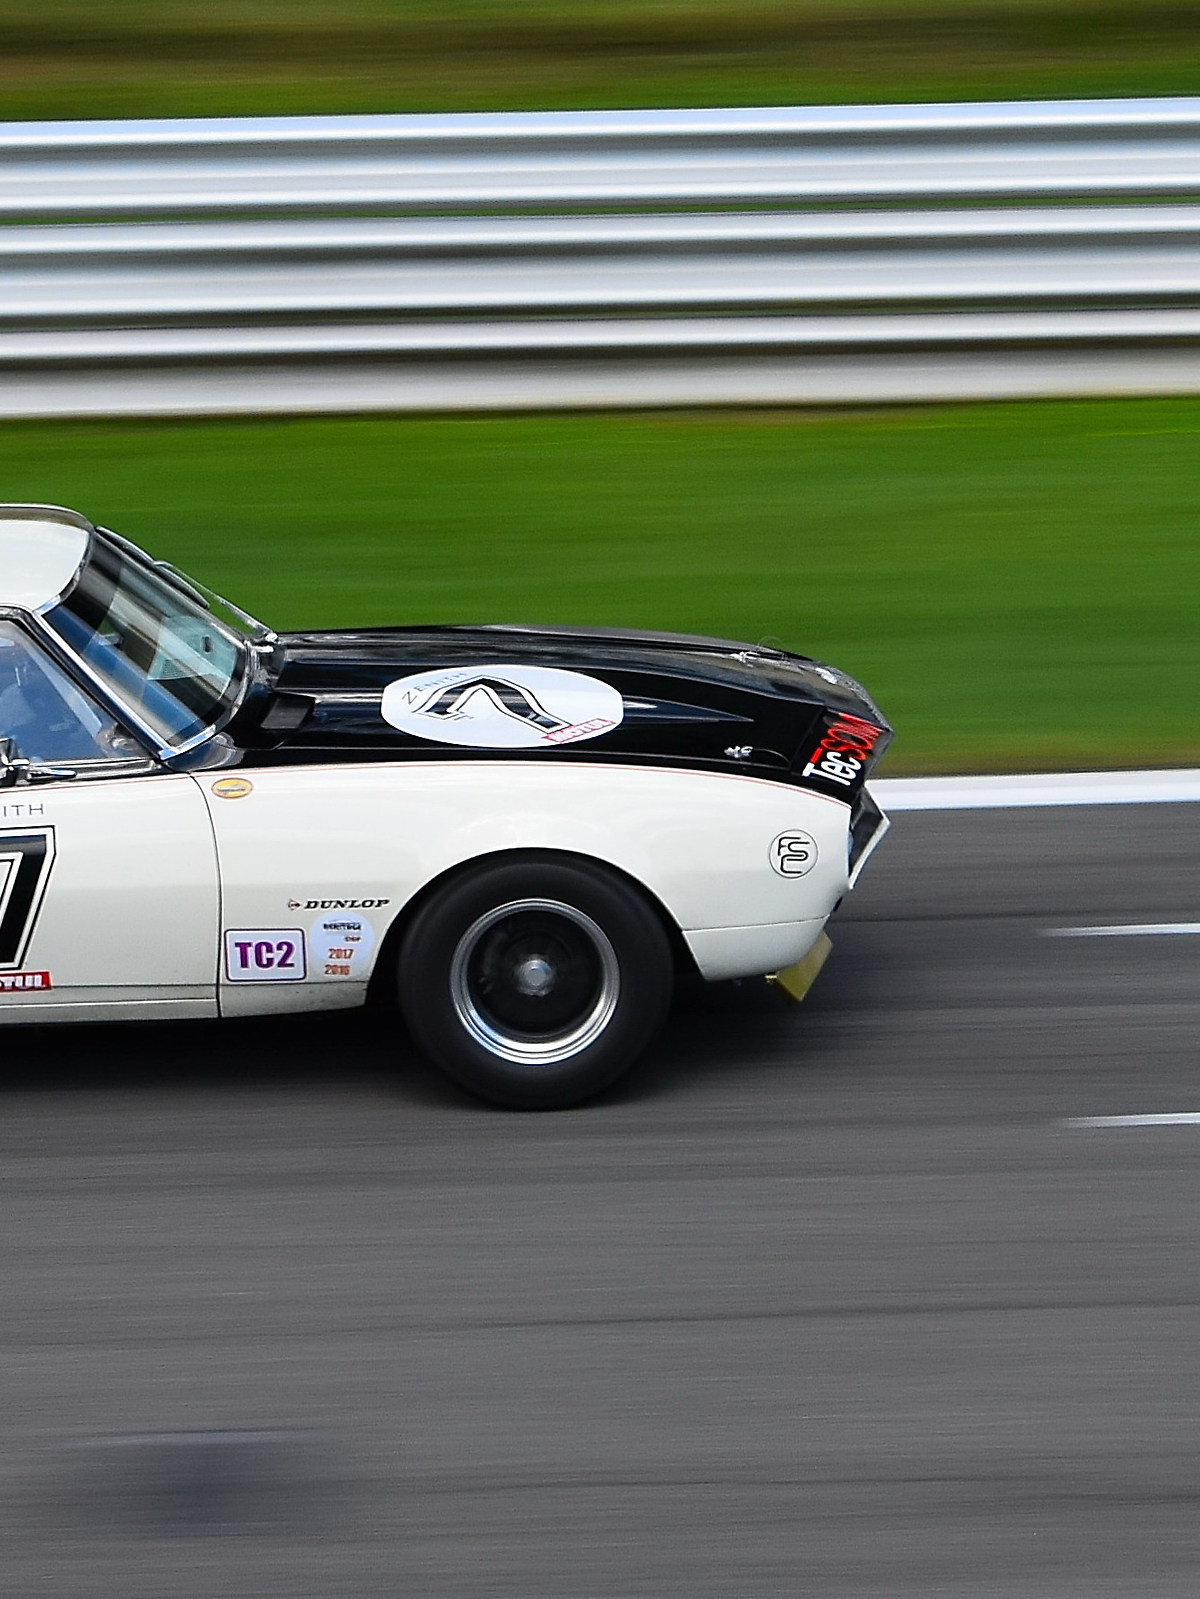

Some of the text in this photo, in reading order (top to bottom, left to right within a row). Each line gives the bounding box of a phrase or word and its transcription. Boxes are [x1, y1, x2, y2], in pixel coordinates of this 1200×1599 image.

[411, 674, 574, 734] 7
[303, 899, 391, 910] DUNLOP
[234, 941, 295, 969] TC2
[328, 948, 354, 959] 2017
